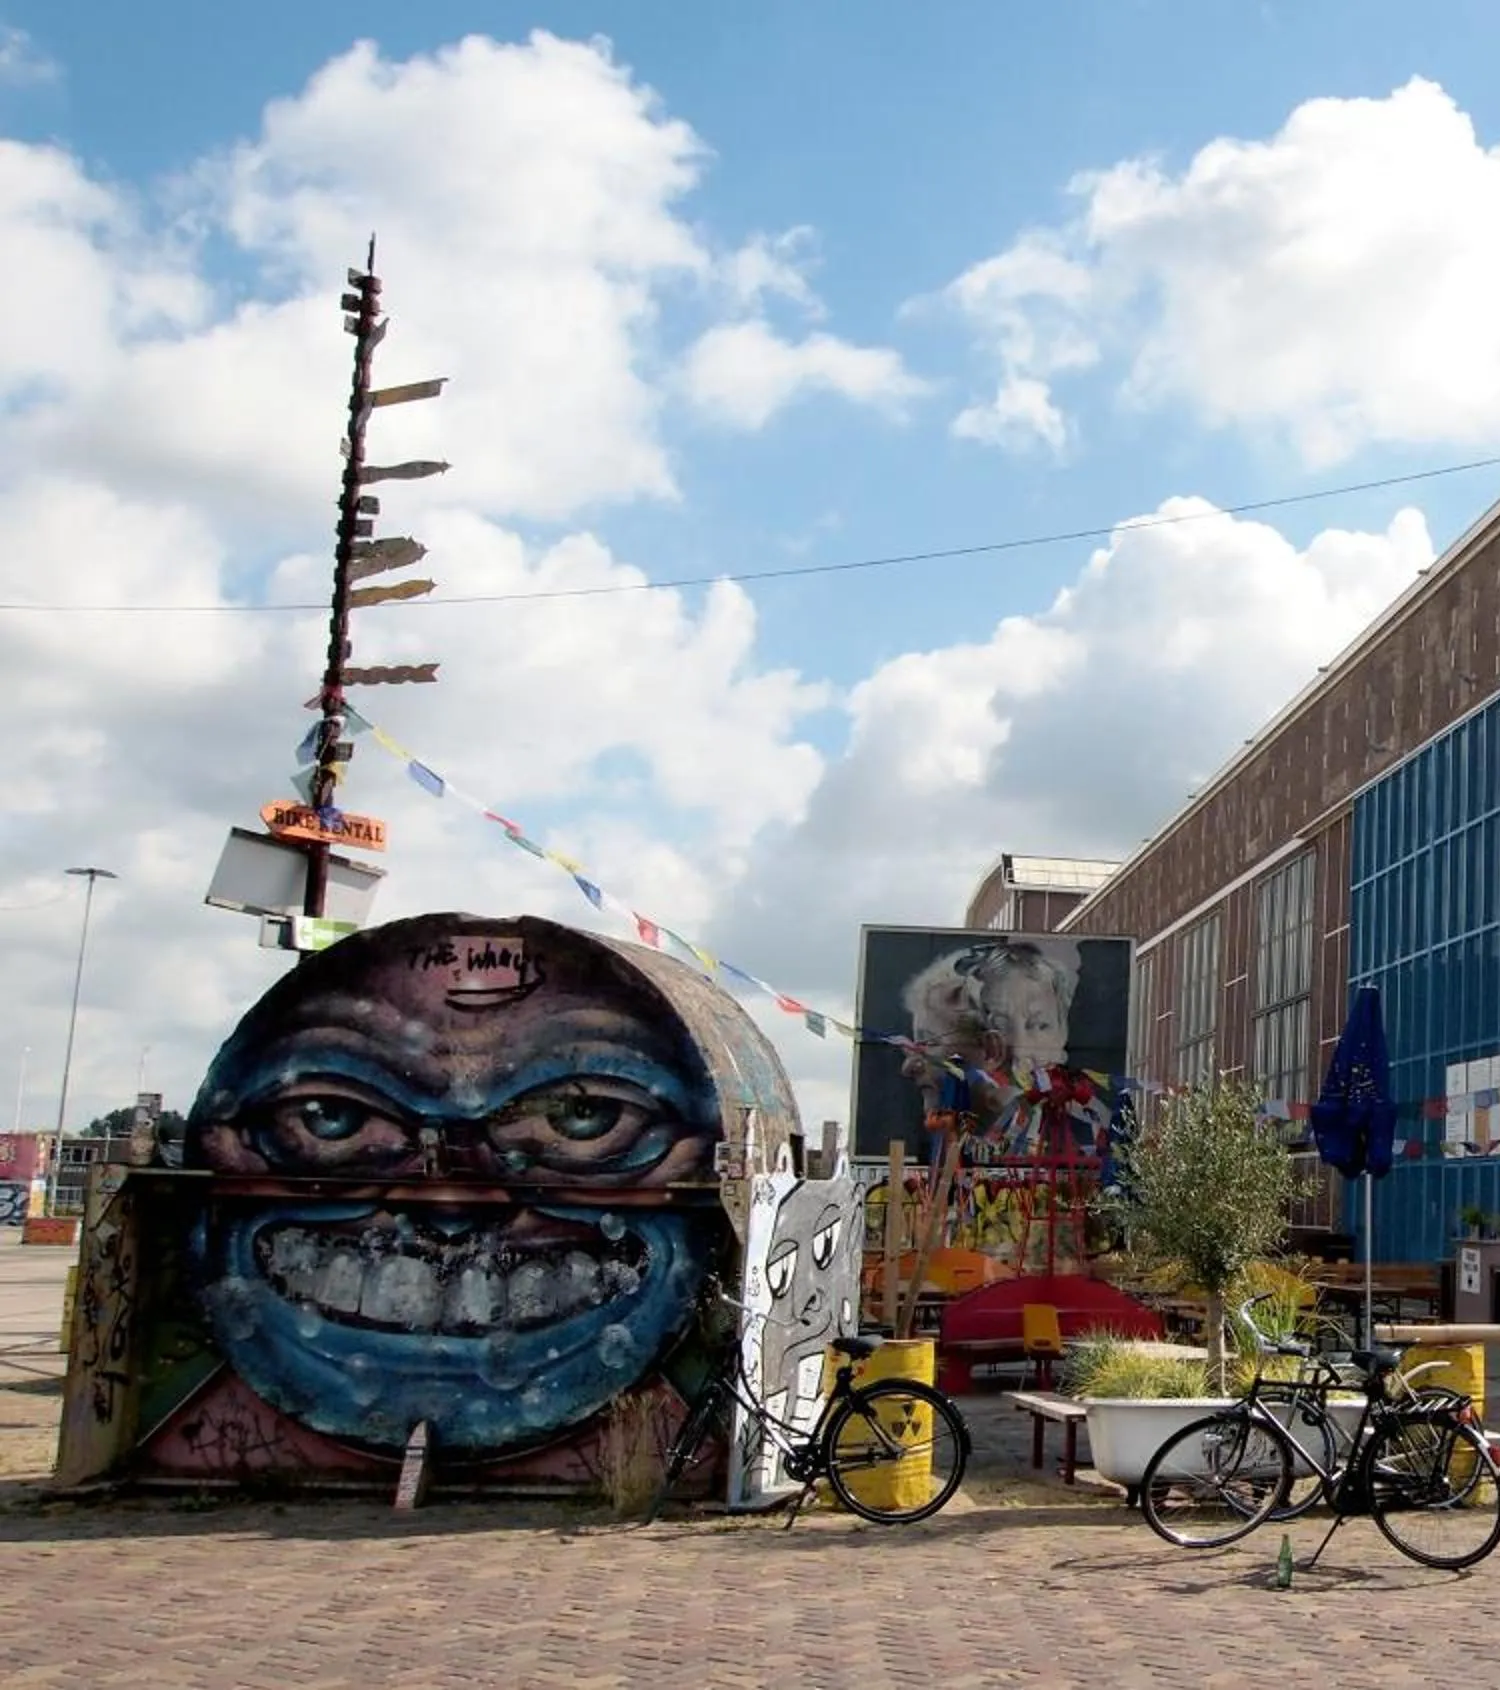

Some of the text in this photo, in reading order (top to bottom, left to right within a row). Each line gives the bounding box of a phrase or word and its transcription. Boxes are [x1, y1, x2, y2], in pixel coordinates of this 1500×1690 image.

[273, 807, 384, 842] BIKE ENTAL
[405, 942, 459, 971] THE
